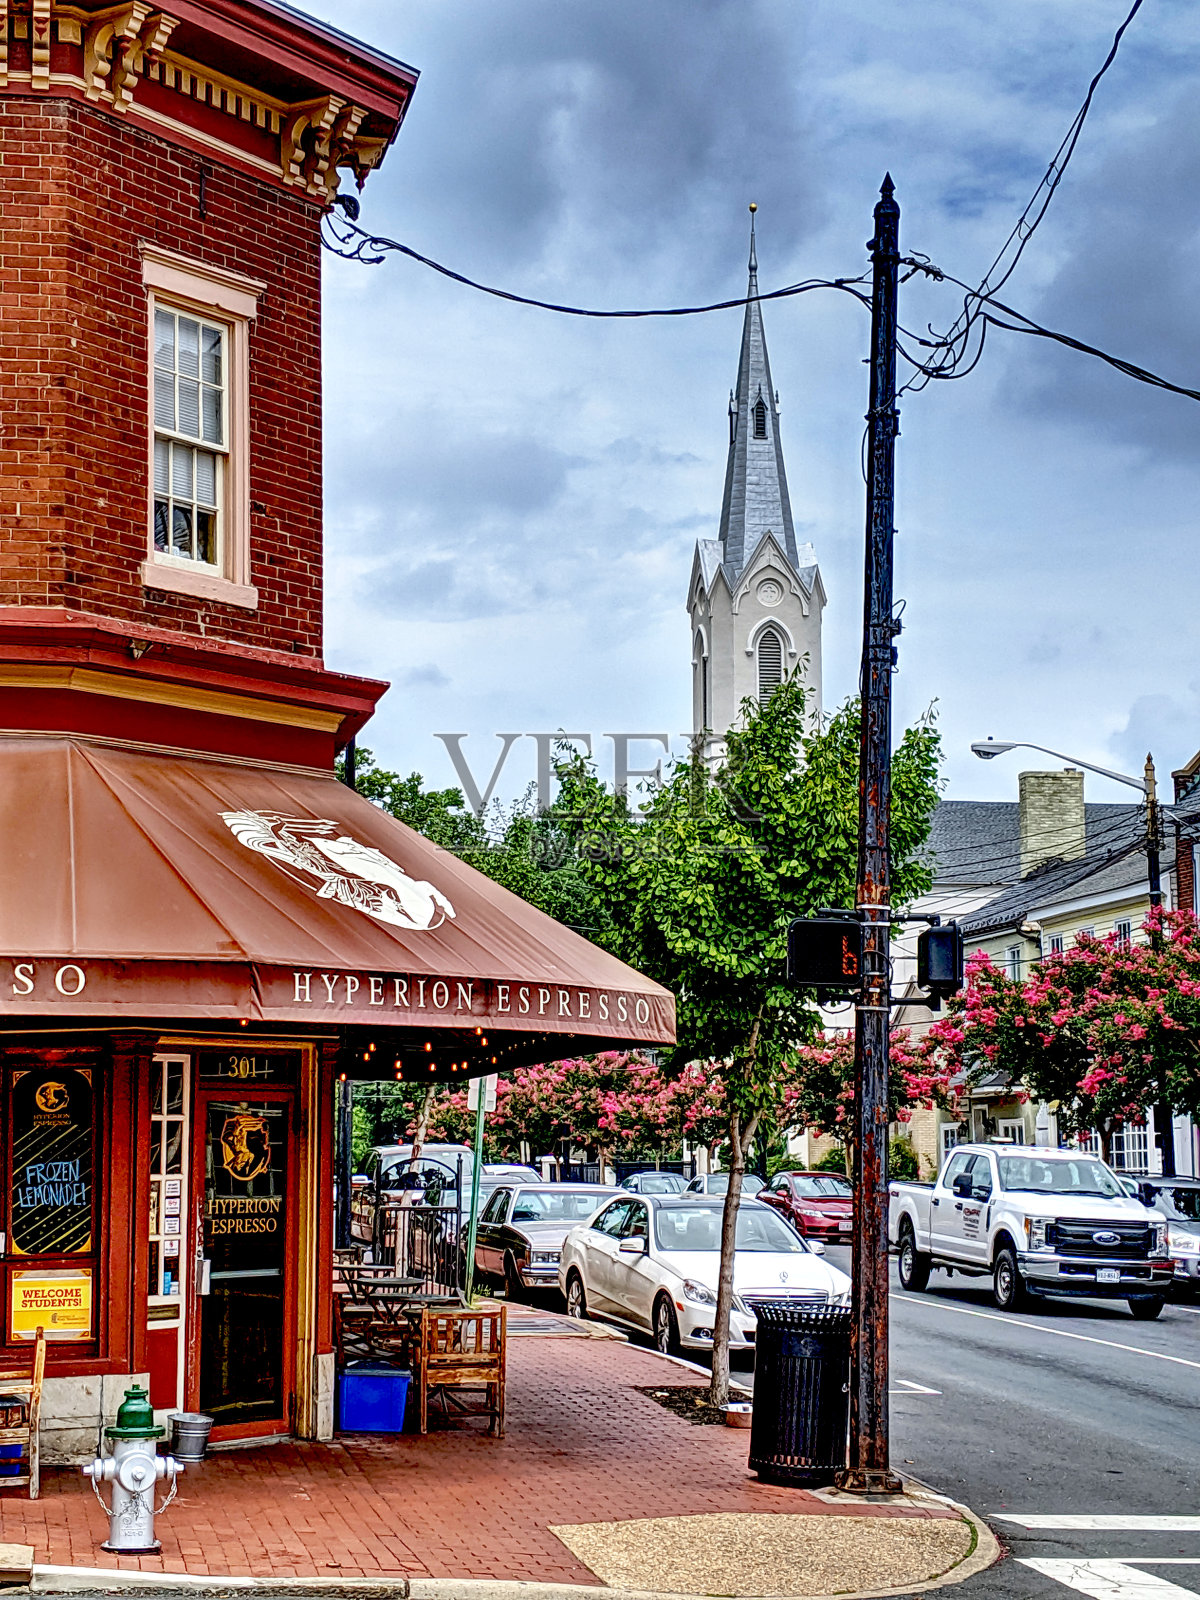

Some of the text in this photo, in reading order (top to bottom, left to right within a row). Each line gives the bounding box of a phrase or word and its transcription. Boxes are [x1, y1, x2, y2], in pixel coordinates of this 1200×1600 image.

[293, 972, 650, 1024] HYPERION ESPRESSO
[228, 1056, 258, 1078] 301
[26, 1158, 80, 1184] FROZEN
[18, 1182, 86, 1208] LEMONADE!
[207, 1198, 280, 1215] HYPERION
[211, 1217, 277, 1235] ESPRESSO
[21, 1298, 82, 1308] STUDENTS!
[22, 1288, 81, 1299] WELCOME
